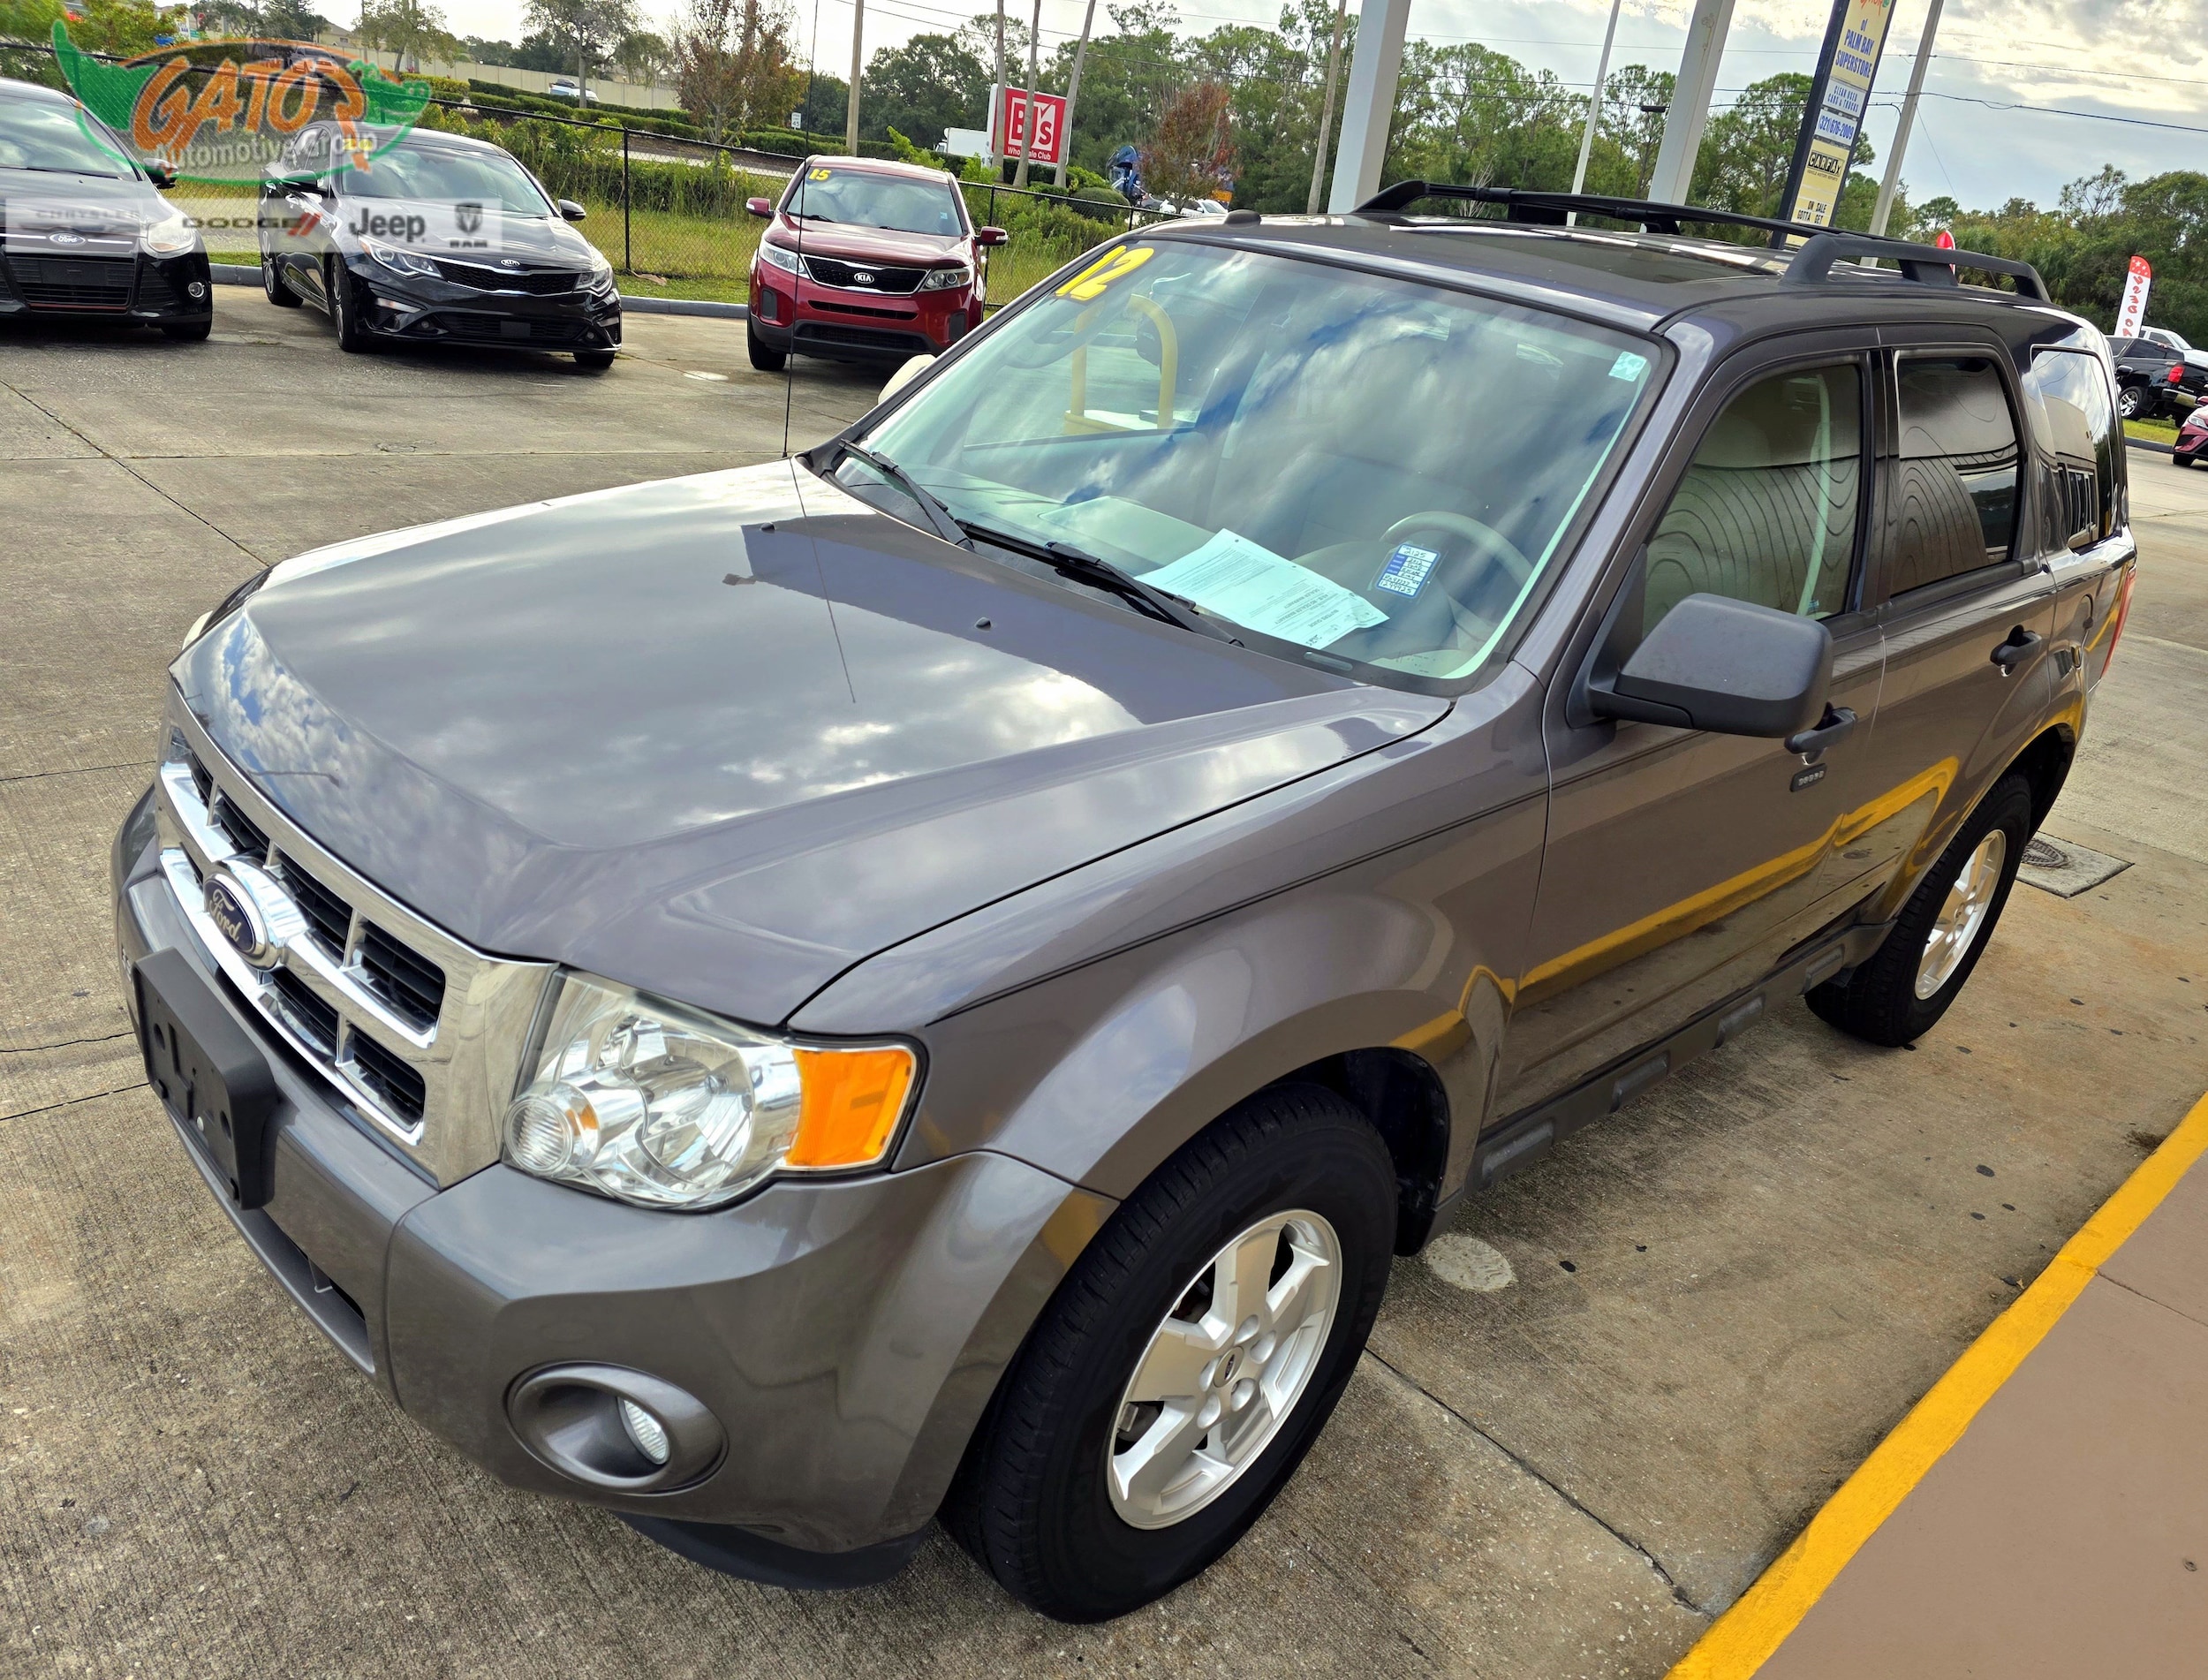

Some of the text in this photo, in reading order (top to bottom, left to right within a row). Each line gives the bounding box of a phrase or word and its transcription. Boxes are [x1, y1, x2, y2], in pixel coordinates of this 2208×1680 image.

[1860, 19, 1869, 32] of
[1843, 28, 1874, 56] PALM BAY
[1835, 49, 1872, 78] SUPERSTORE
[1834, 86, 1857, 102] CLEAN USED
[1827, 94, 1838, 105] CARS
[1843, 100, 1859, 112] TRUCKS
[1008, 146, 1051, 161] Whoale Club
[1808, 153, 1841, 176] CARFAX
[809, 168, 832, 181] 15
[1816, 202, 1827, 214] SALE
[1796, 210, 1823, 224] GOTTA GET
[1055, 245, 1154, 301] 12
[208, 889, 242, 942] Ford
